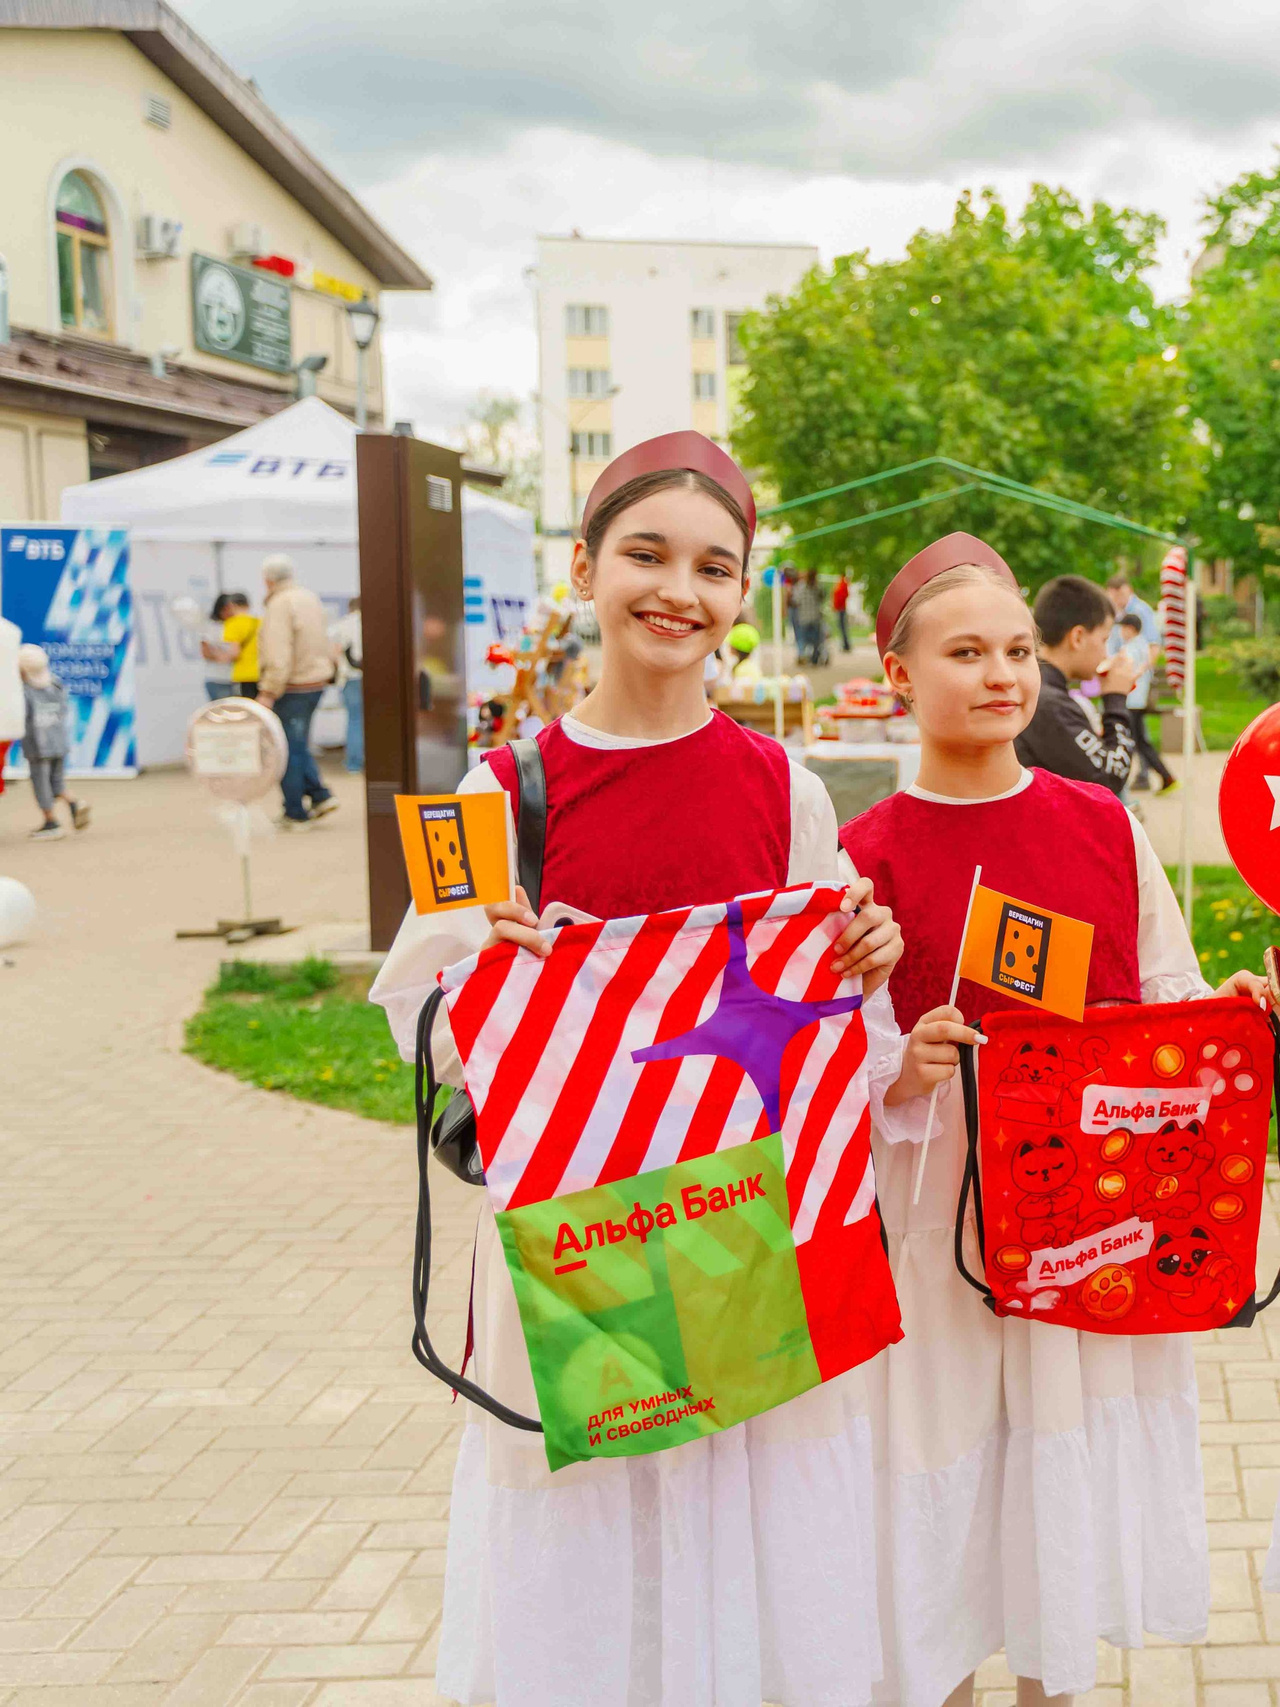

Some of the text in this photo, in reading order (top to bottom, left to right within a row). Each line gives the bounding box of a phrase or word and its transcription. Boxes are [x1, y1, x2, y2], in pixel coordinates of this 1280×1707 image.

[250, 456, 348, 479] ВТБ
[26, 539, 65, 560] ВТБ
[423, 809, 456, 819] ВЕРЕЩАГИН
[438, 884, 469, 898] СЫРФЕСТ
[1008, 909, 1044, 928] ВЕРЕЩАГИН
[998, 973, 1036, 993] СЫРФЕСТ
[1092, 1100, 1200, 1125] Альфа Банк
[553, 1172, 766, 1275] Альфа Банк
[1039, 1229, 1144, 1280] Альфа Банк
